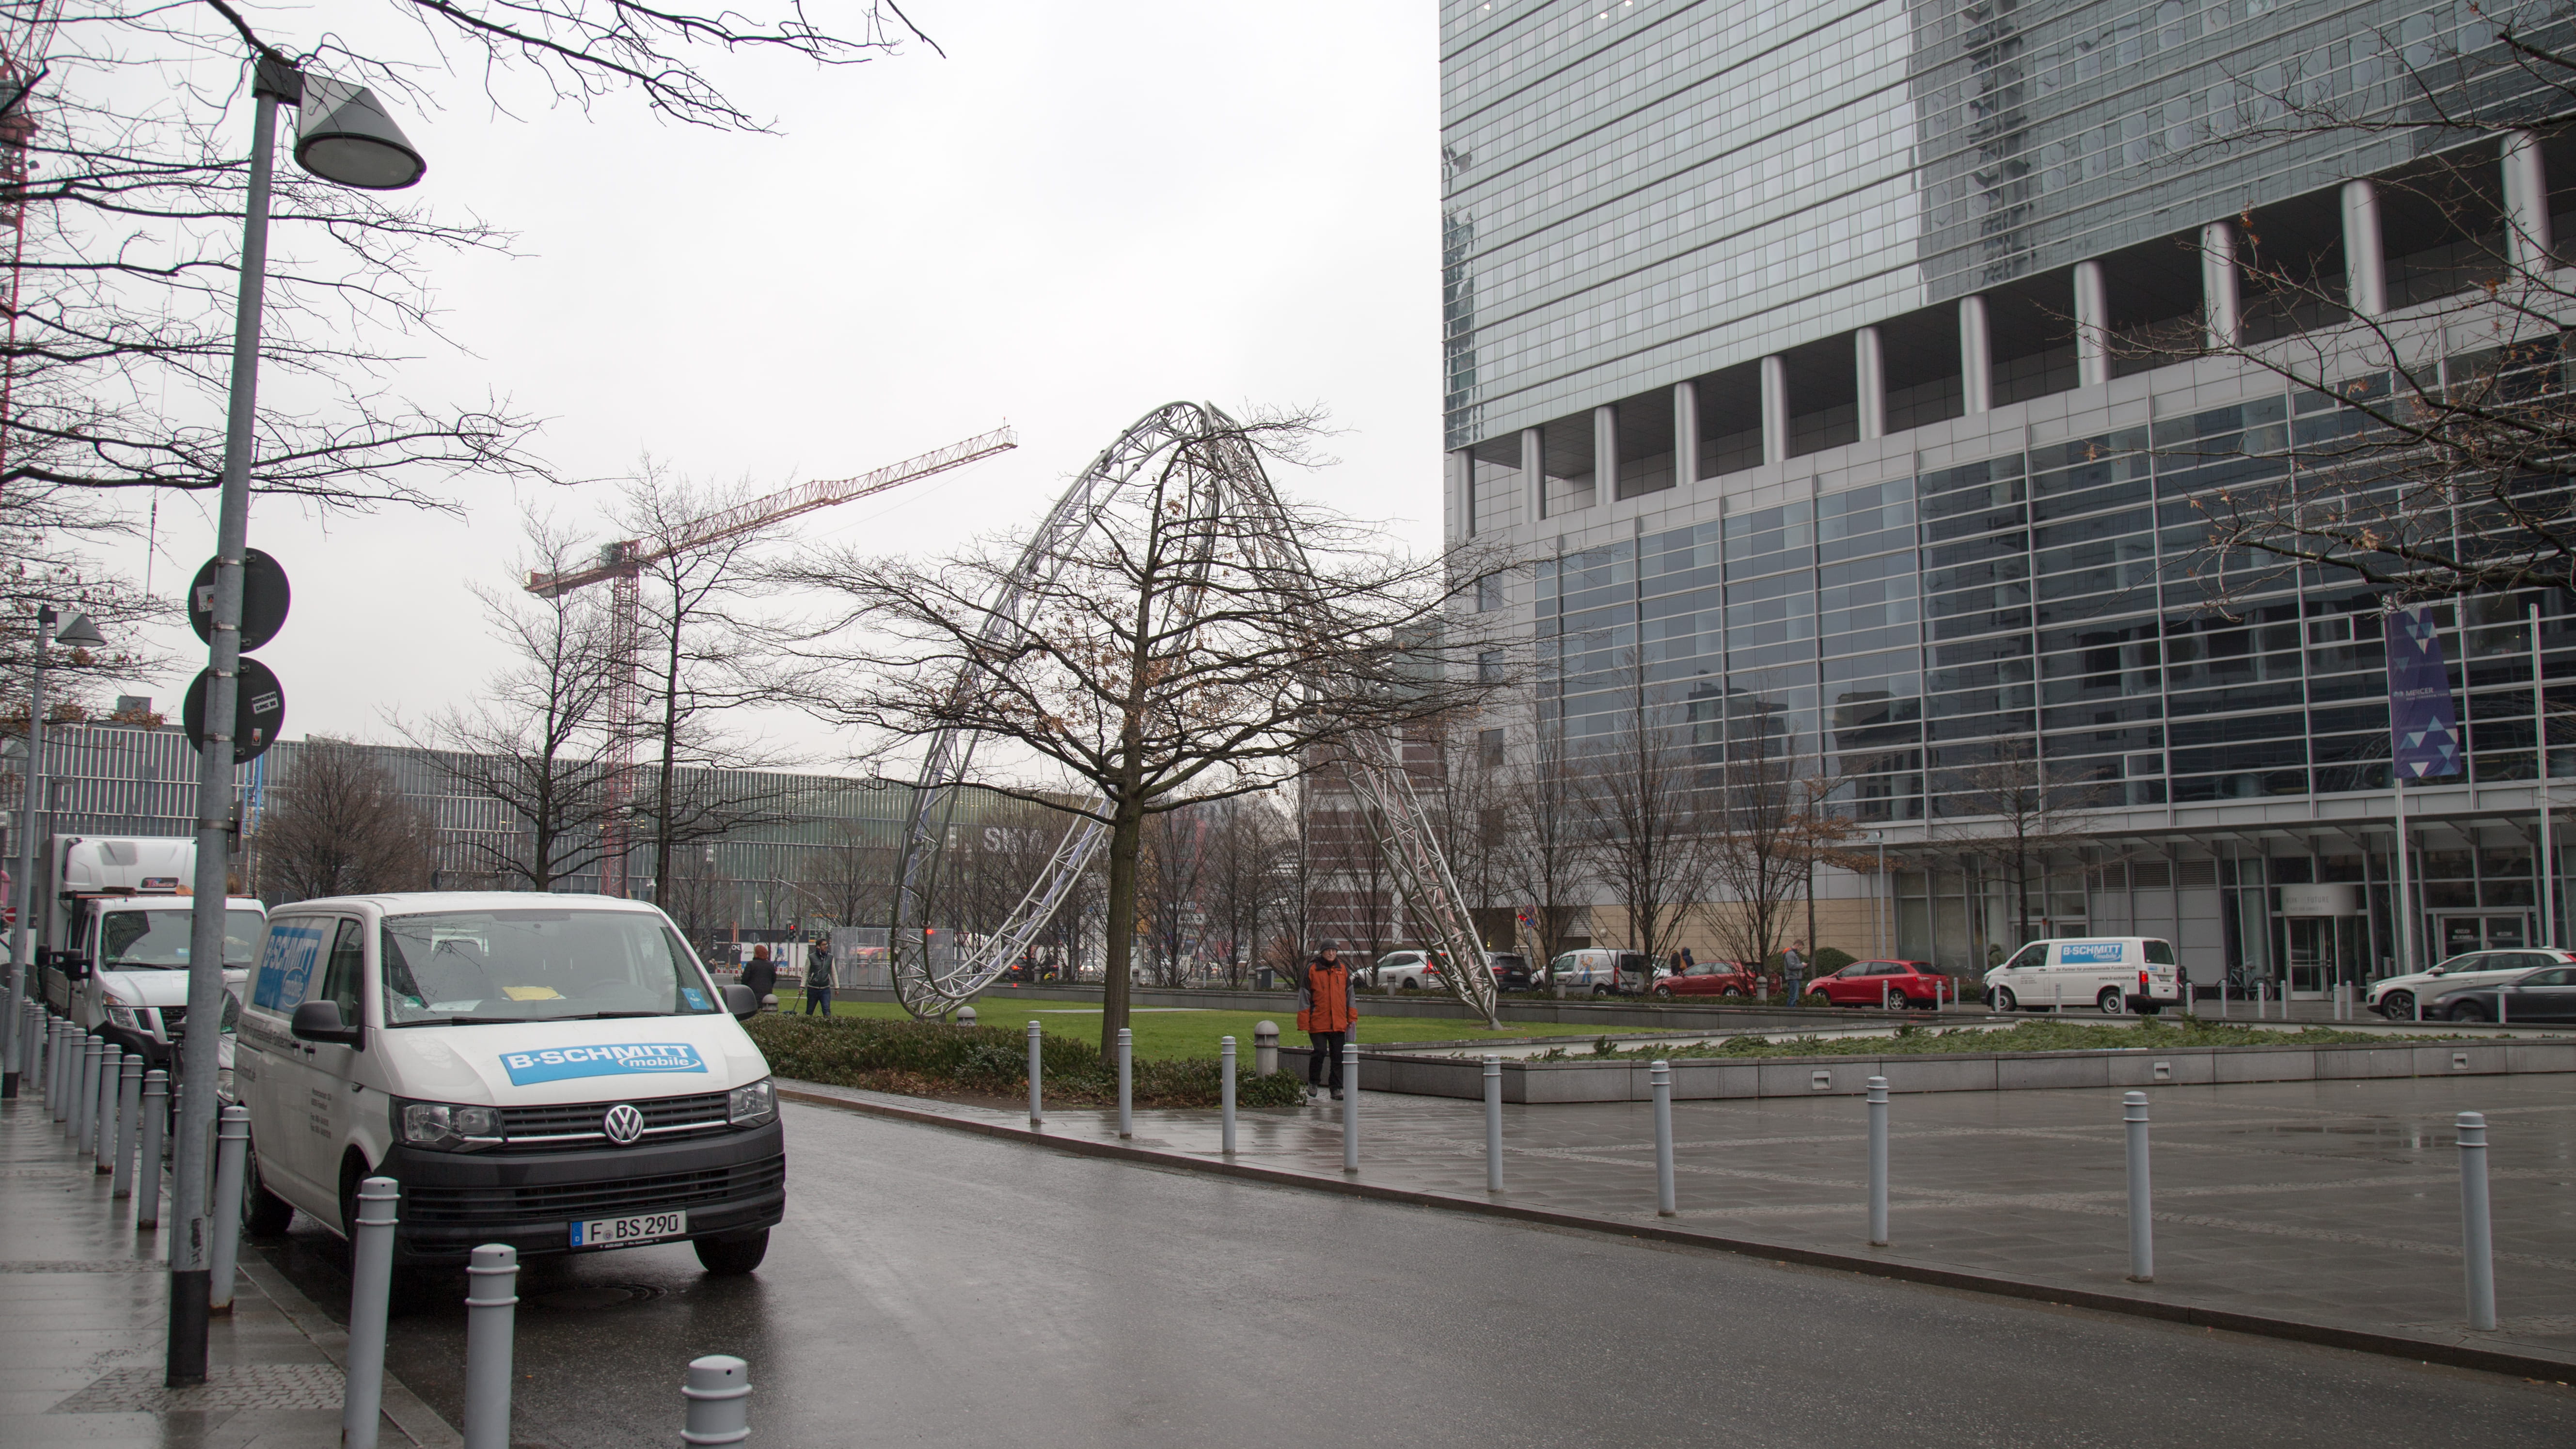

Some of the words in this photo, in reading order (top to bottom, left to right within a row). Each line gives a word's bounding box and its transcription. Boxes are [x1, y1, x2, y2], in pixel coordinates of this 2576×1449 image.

[2405, 687, 2434, 696] MERCER
[630, 1056, 689, 1067] mobile
[591, 1223, 603, 1241] F
[645, 1214, 679, 1235] 290
